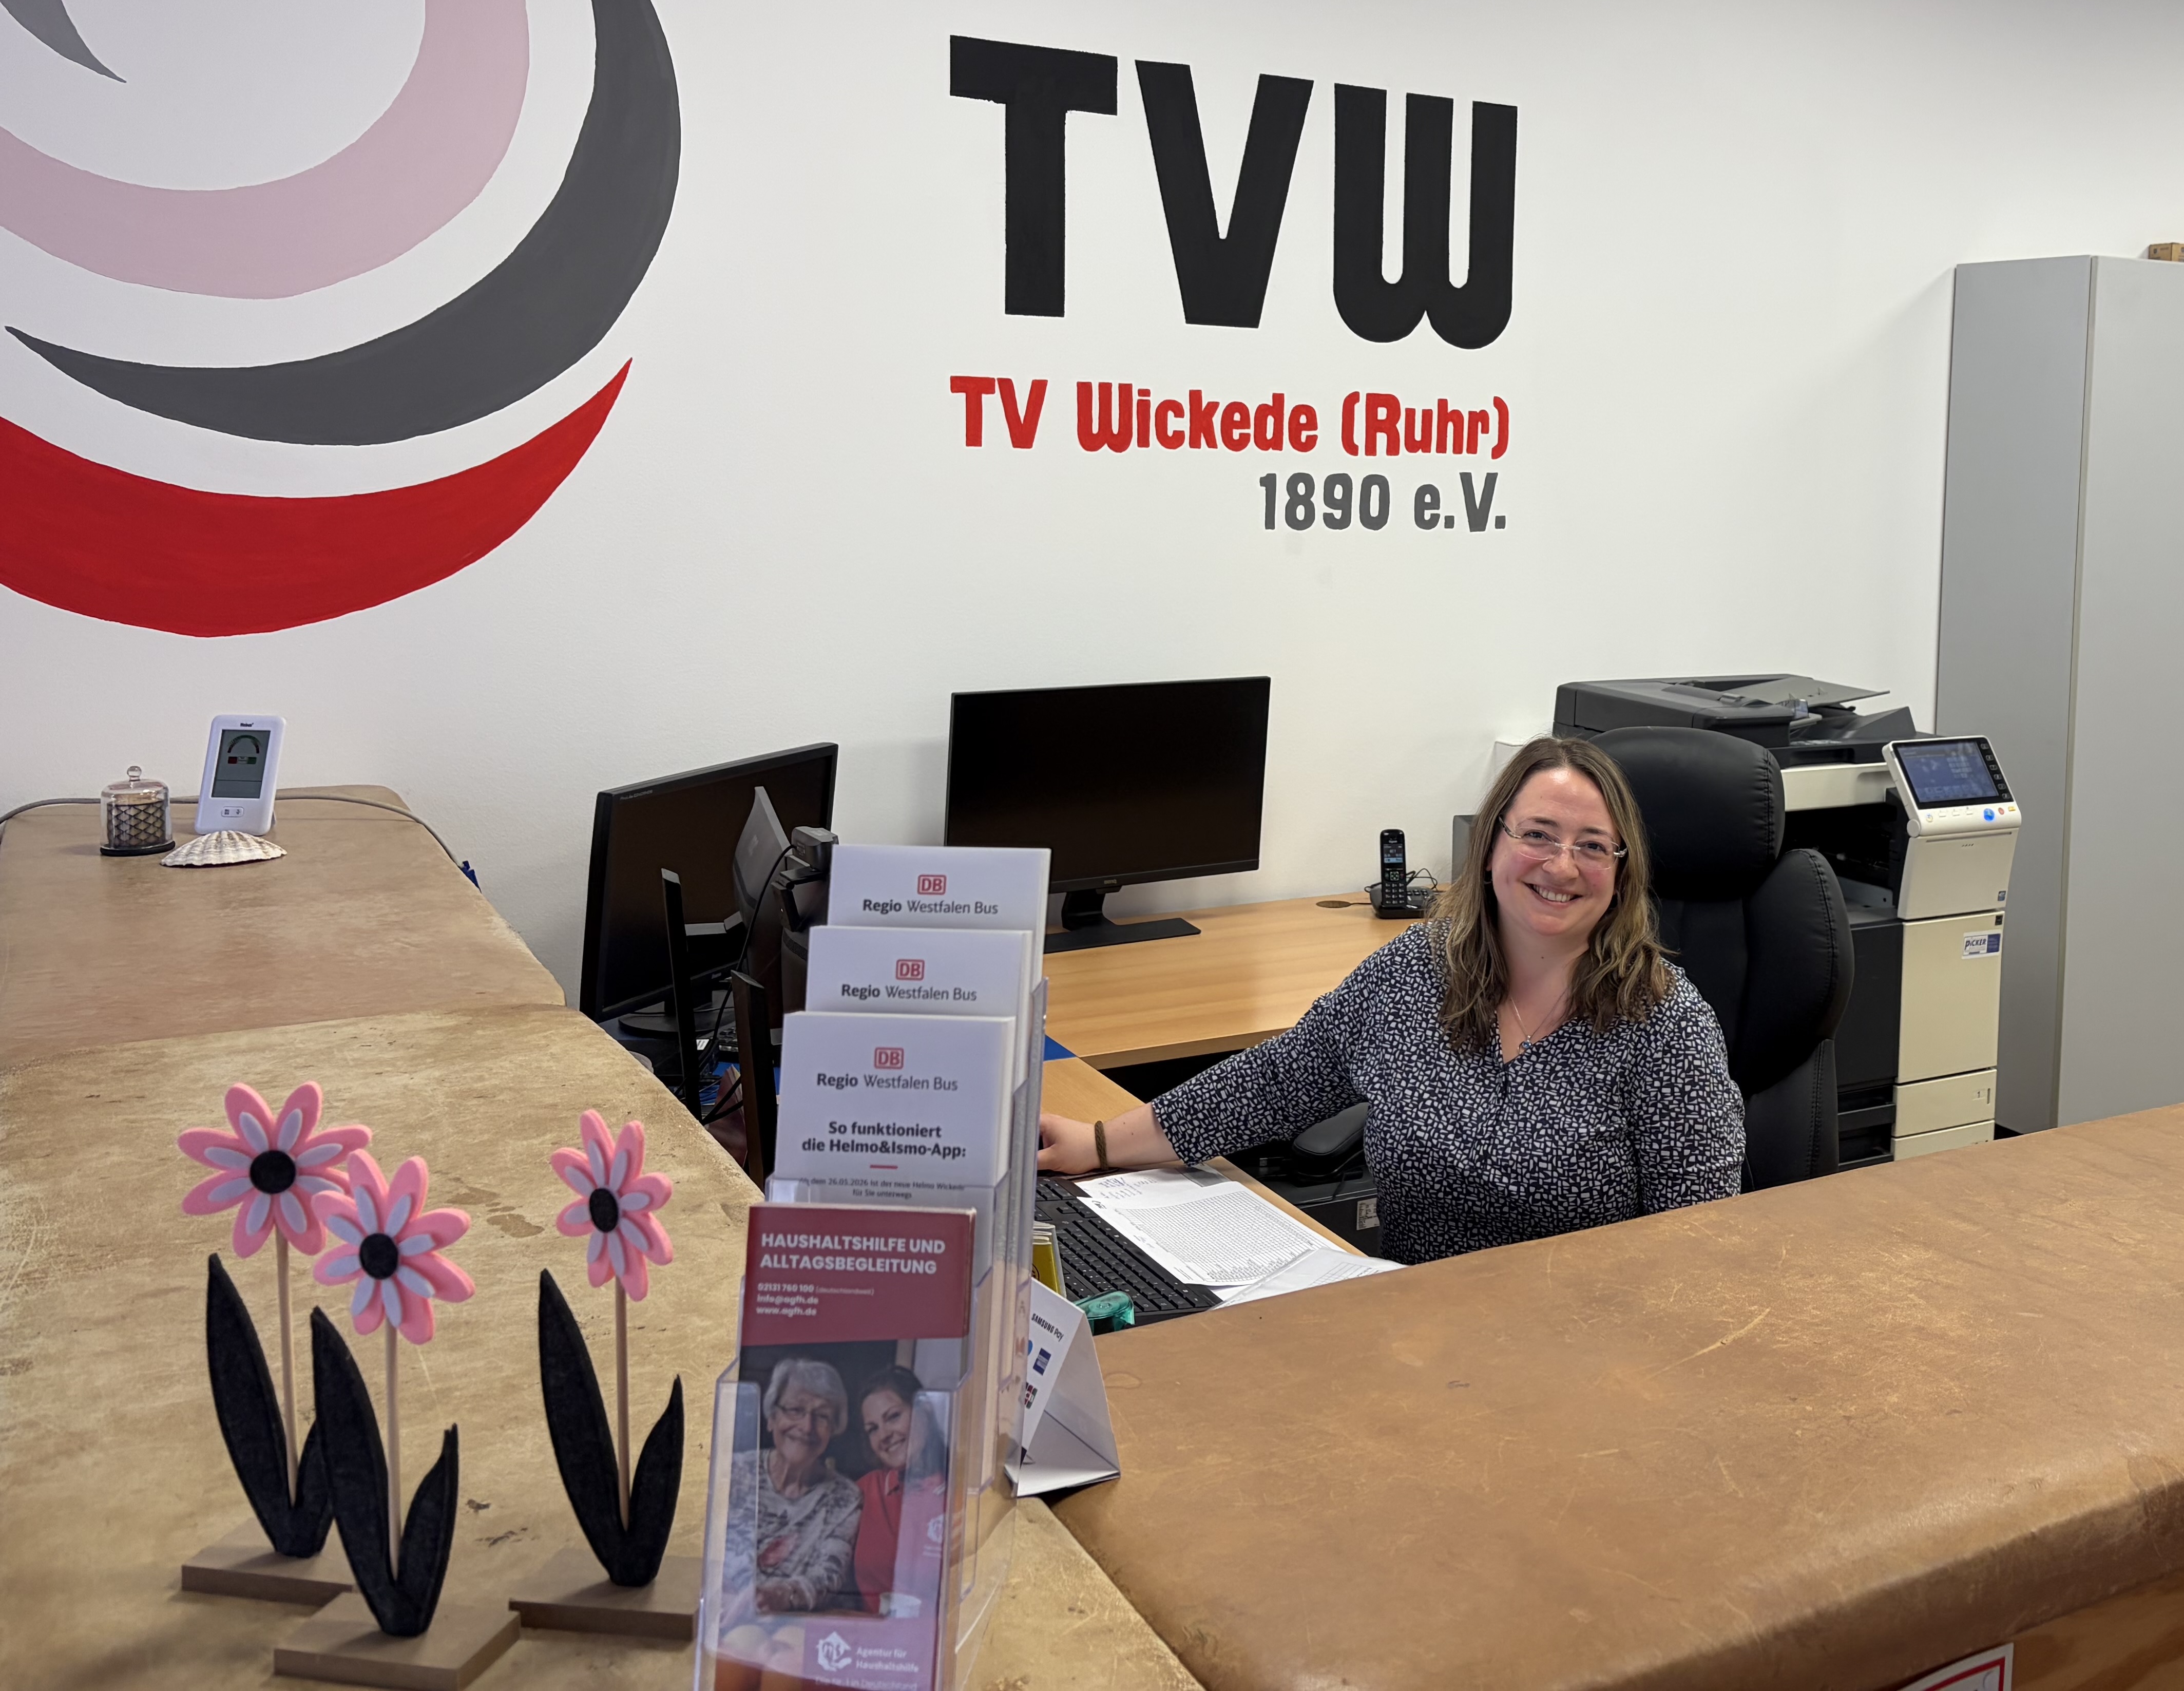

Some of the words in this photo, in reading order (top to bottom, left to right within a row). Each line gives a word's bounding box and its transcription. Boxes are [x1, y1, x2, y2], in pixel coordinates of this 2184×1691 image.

[950, 35, 1517, 349] TVW
[950, 375, 1048, 449] TV
[1077, 382, 1318, 452] Wickede
[1342, 391, 1509, 459] (Ruhr)
[1259, 472, 1390, 531] 1890
[1414, 472, 1506, 532] e.V.
[921, 877, 944, 892] DB
[863, 899, 902, 915] Regio
[907, 900, 970, 914] Westfalen
[974, 901, 999, 914] Bus
[899, 962, 922, 978] DB
[841, 984, 880, 999] Regio
[886, 985, 949, 1000] Westfalen
[953, 987, 978, 1001] Bus
[877, 1050, 901, 1067] DB
[817, 1073, 858, 1090] Regio
[864, 1074, 929, 1090] Westfalen
[933, 1077, 958, 1091] Bus
[829, 1122, 847, 1135] So
[852, 1122, 942, 1138] funktioniert
[802, 1138, 825, 1152] die
[830, 1139, 966, 1160] Helmo&Ismo-App:
[877, 1190, 912, 1199] unterwegs
[761, 1233, 906, 1252] HAUSHALTSHILFE
[909, 1239, 946, 1254] UND
[760, 1255, 937, 1275] ALLTAGSBEGLEITUNG
[757, 1282, 780, 1291] 02131
[1031, 1313, 1055, 1334] SAMSUNG
[1053, 1327, 1064, 1342] Pay
[856, 1646, 892, 1658] Agentur
[894, 1648, 907, 1659] für
[856, 1660, 919, 1673] Haushaltshilfe
